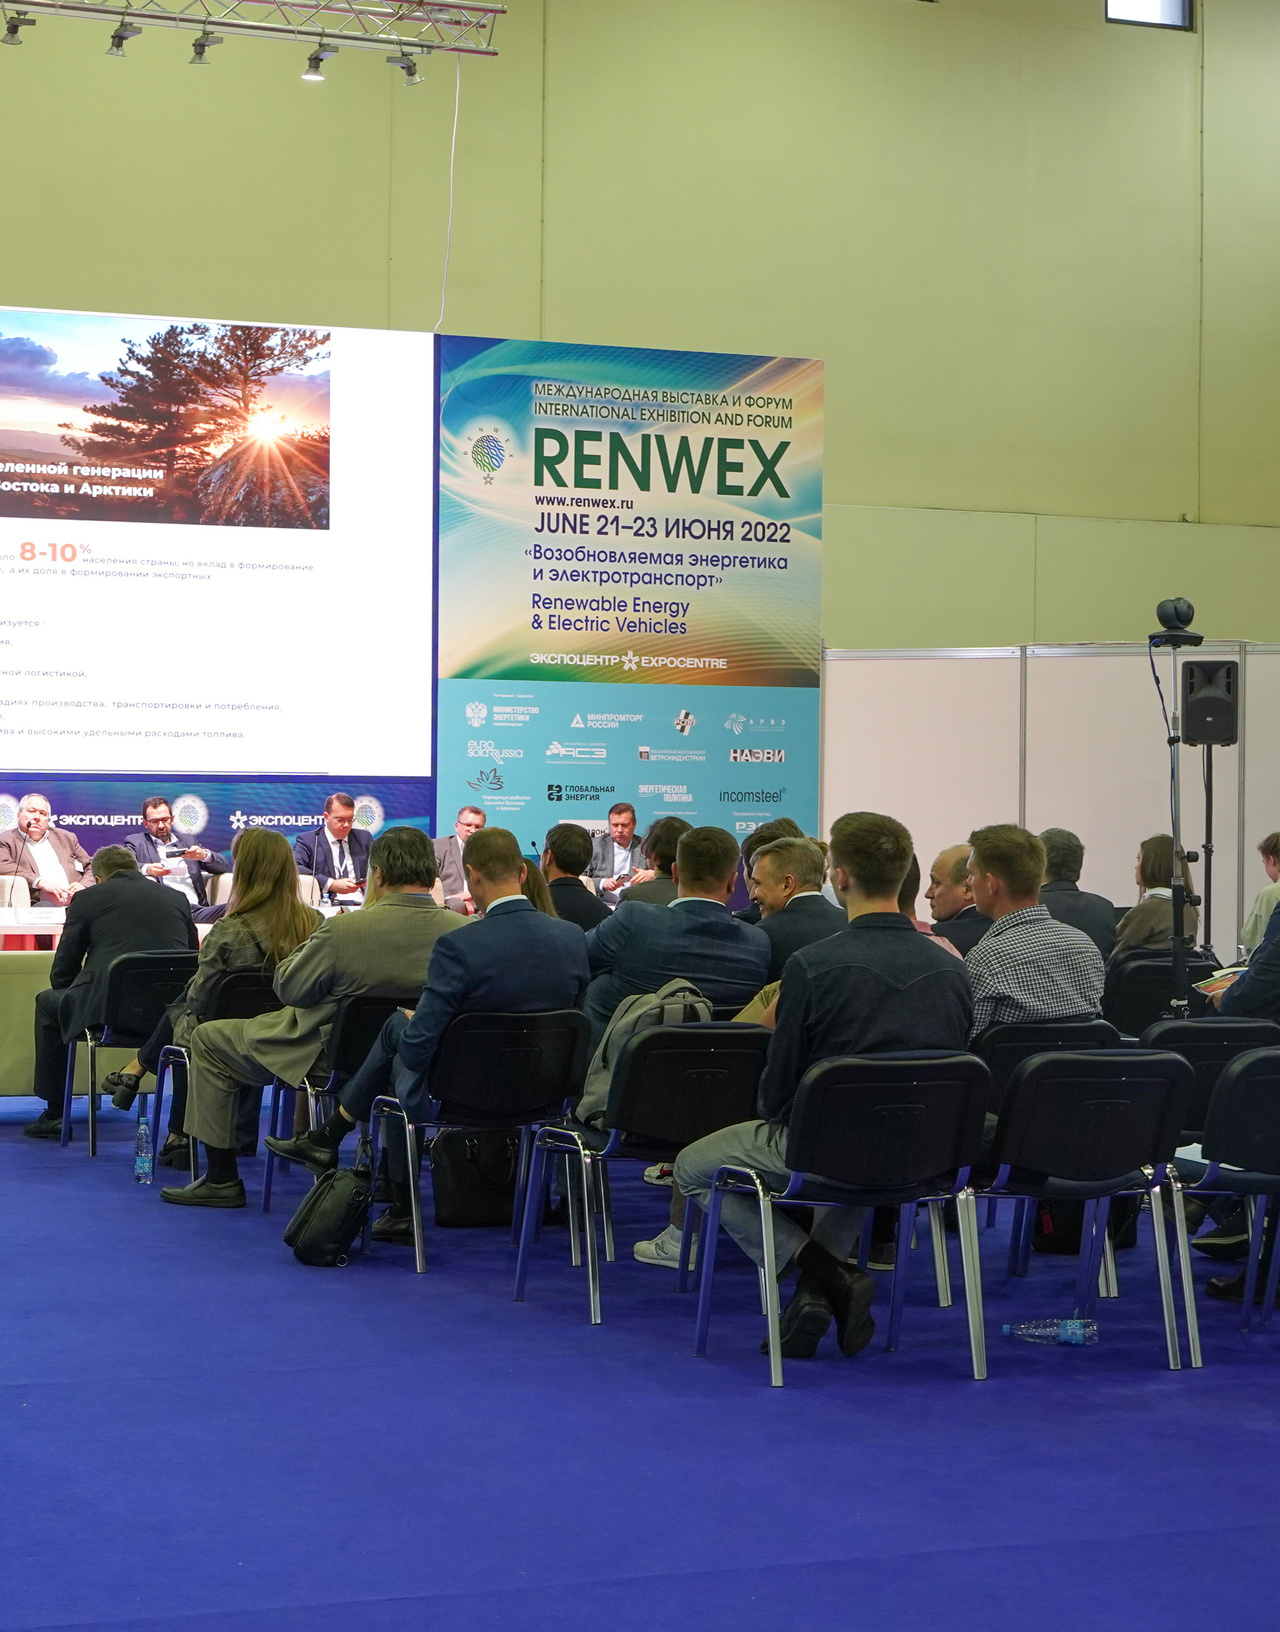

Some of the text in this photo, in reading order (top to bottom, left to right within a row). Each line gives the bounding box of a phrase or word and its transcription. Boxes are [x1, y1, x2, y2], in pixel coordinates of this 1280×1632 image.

[535, 383, 793, 410] МЕЖДУНАРОДНАЯ ВЫСТАВКА И ФОРУМ
[534, 402, 793, 429] INTERNATIONAL EXHIBITION AND FORUM
[534, 427, 792, 498] RENWEX
[72, 465, 164, 480] генерации
[64, 483, 75, 493] и
[79, 482, 154, 498] Арктики
[534, 496, 633, 509] www.renwex.ru
[534, 512, 590, 534] JUNE
[665, 518, 734, 540] ИЮНЯ
[741, 521, 791, 543] 2022
[688, 553, 788, 571] энергетика
[533, 568, 543, 580] и
[532, 593, 690, 618] Renewable Energy
[531, 613, 687, 634] & Electric Vehicles
[530, 652, 728, 670] ЭКСПОЦЕНТР EXPOCENTRE
[493, 706, 540, 714] МИНИСТЕРСТВО
[587, 713, 644, 722] МИНПРОМТОРГ
[587, 721, 619, 729] РОССИИ
[729, 748, 786, 763] НАЭВИ
[564, 785, 615, 793] ГЛОБАЛЬНАЯ
[564, 793, 600, 801] ЭНЕРГИЯ
[248, 815, 326, 827] ЭКСПОЦЕНТ
